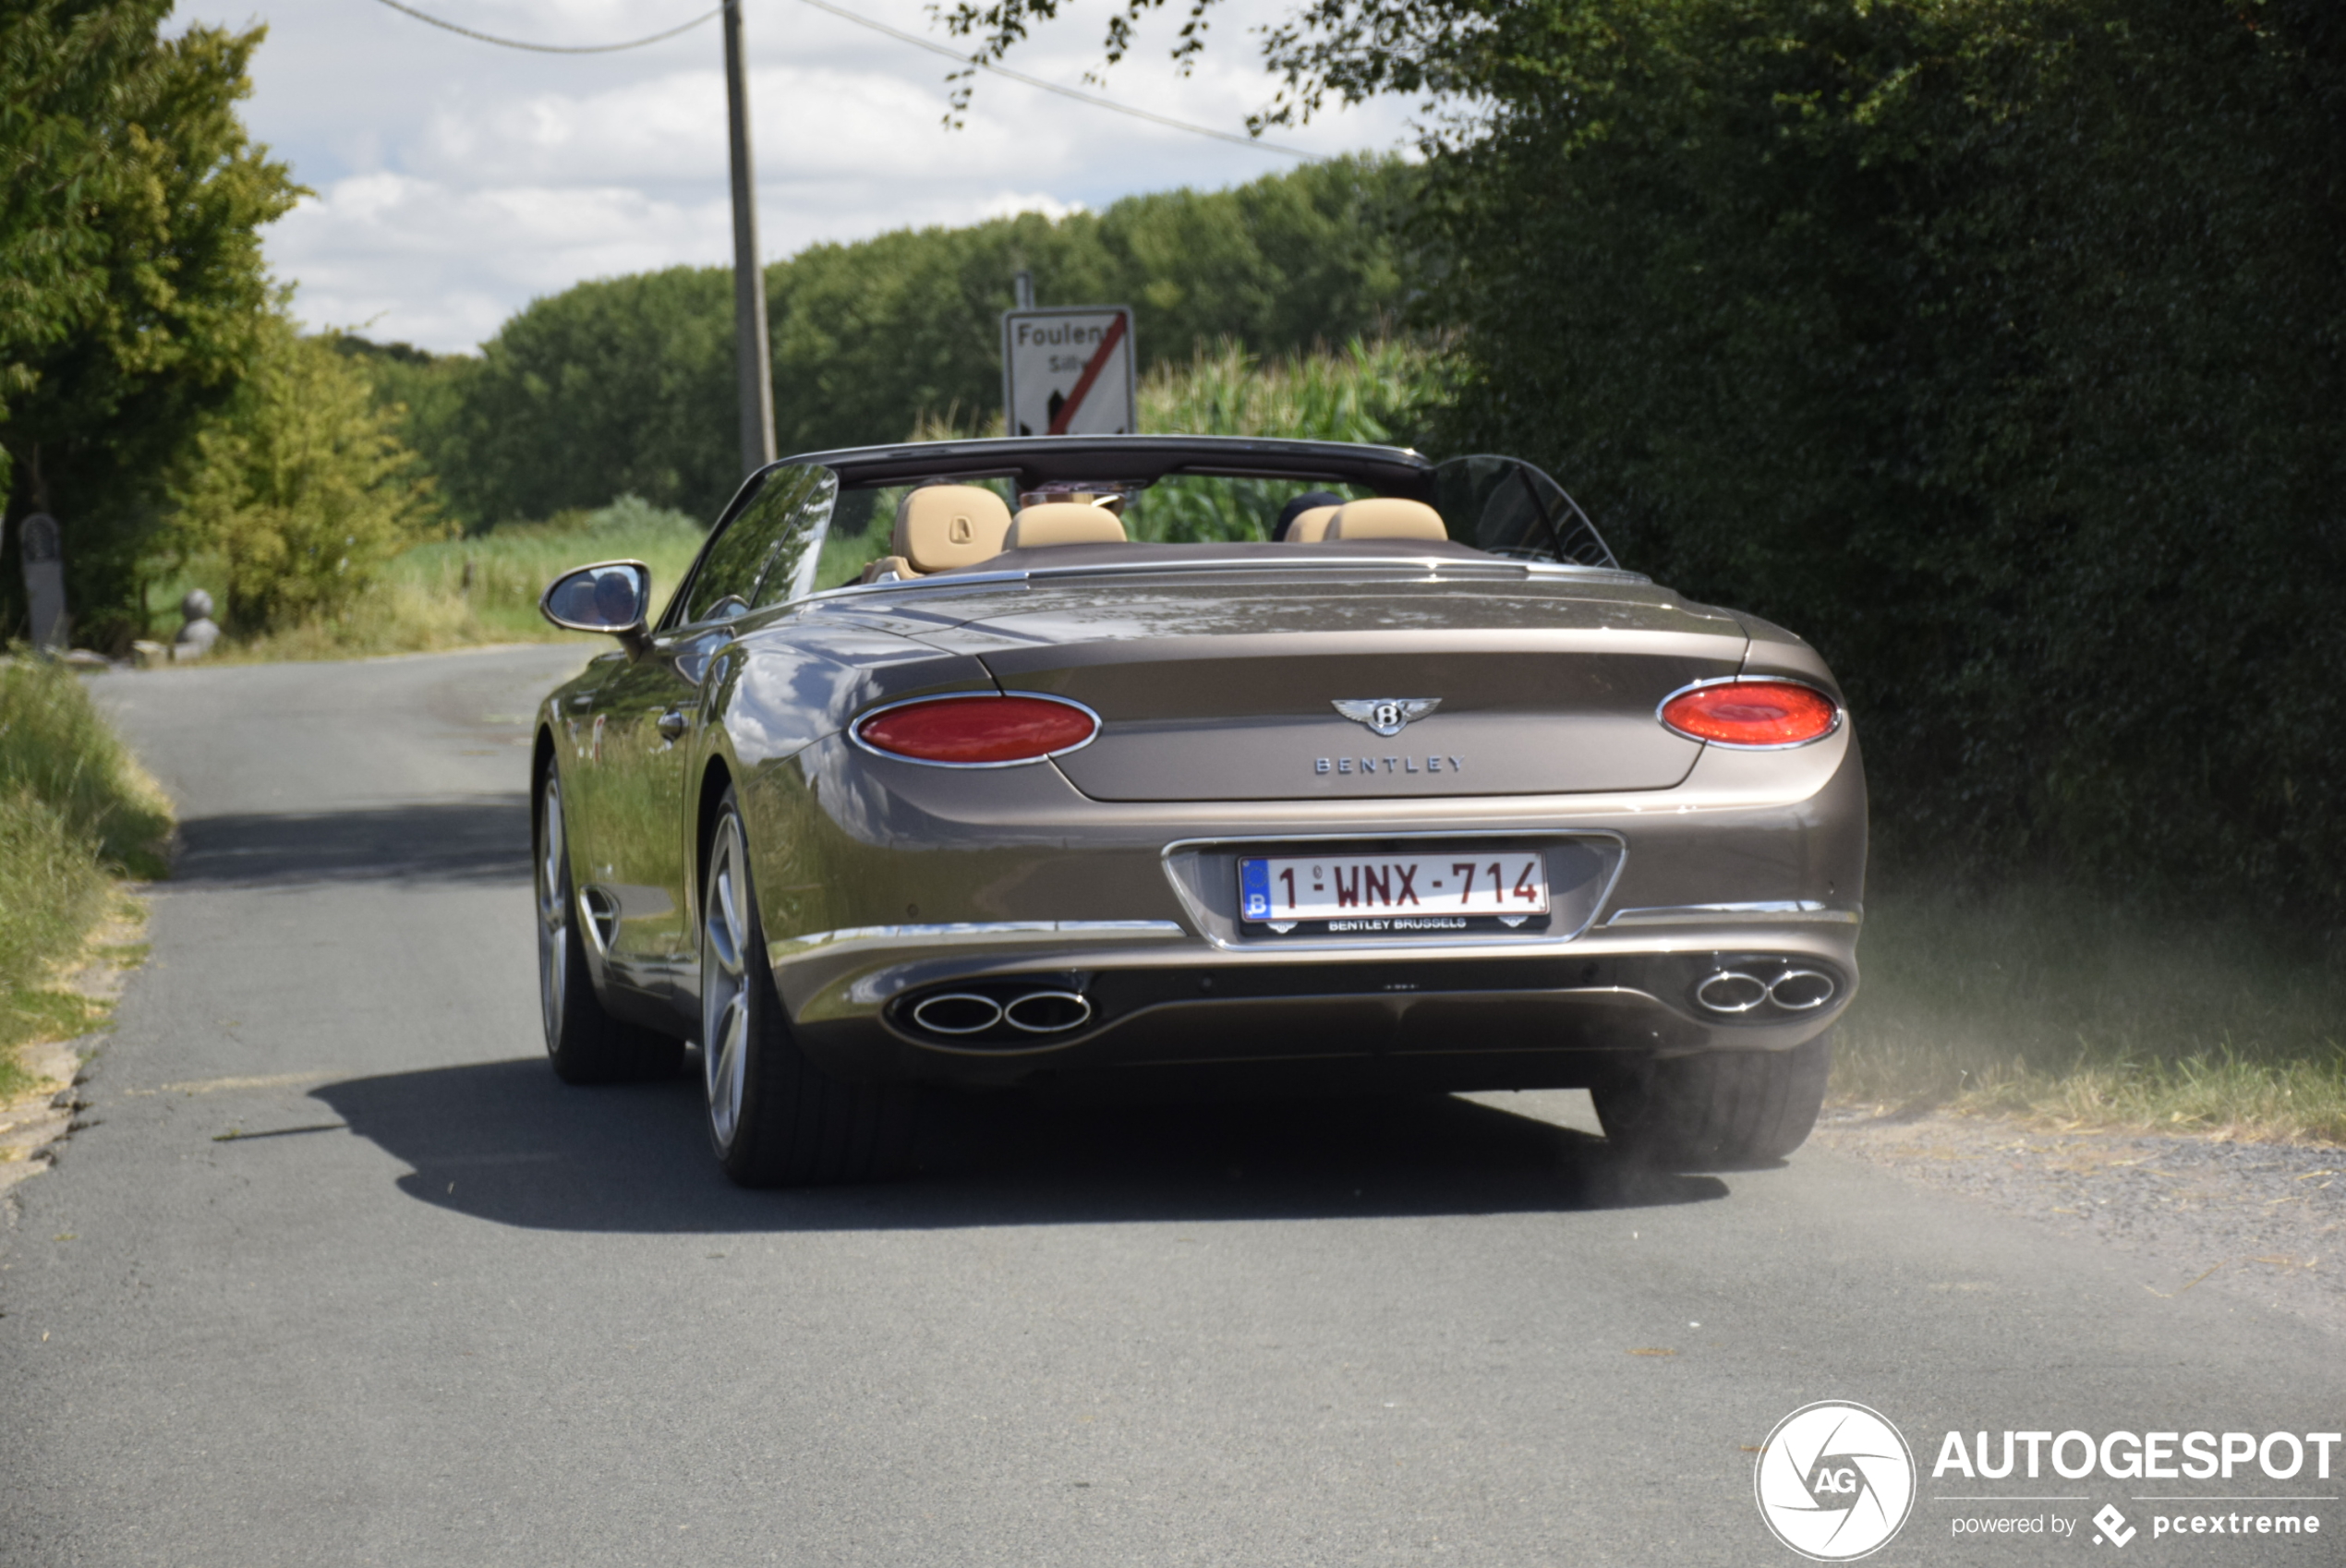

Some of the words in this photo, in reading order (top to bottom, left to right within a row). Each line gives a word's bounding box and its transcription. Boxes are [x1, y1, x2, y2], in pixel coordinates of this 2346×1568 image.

[1376, 705, 1399, 726] B
[1315, 754, 1465, 774] BENTLEY
[1250, 894, 1266, 914] B
[1328, 920, 1391, 931] BENTLEY
[1394, 918, 1467, 930] BRUSSELS
